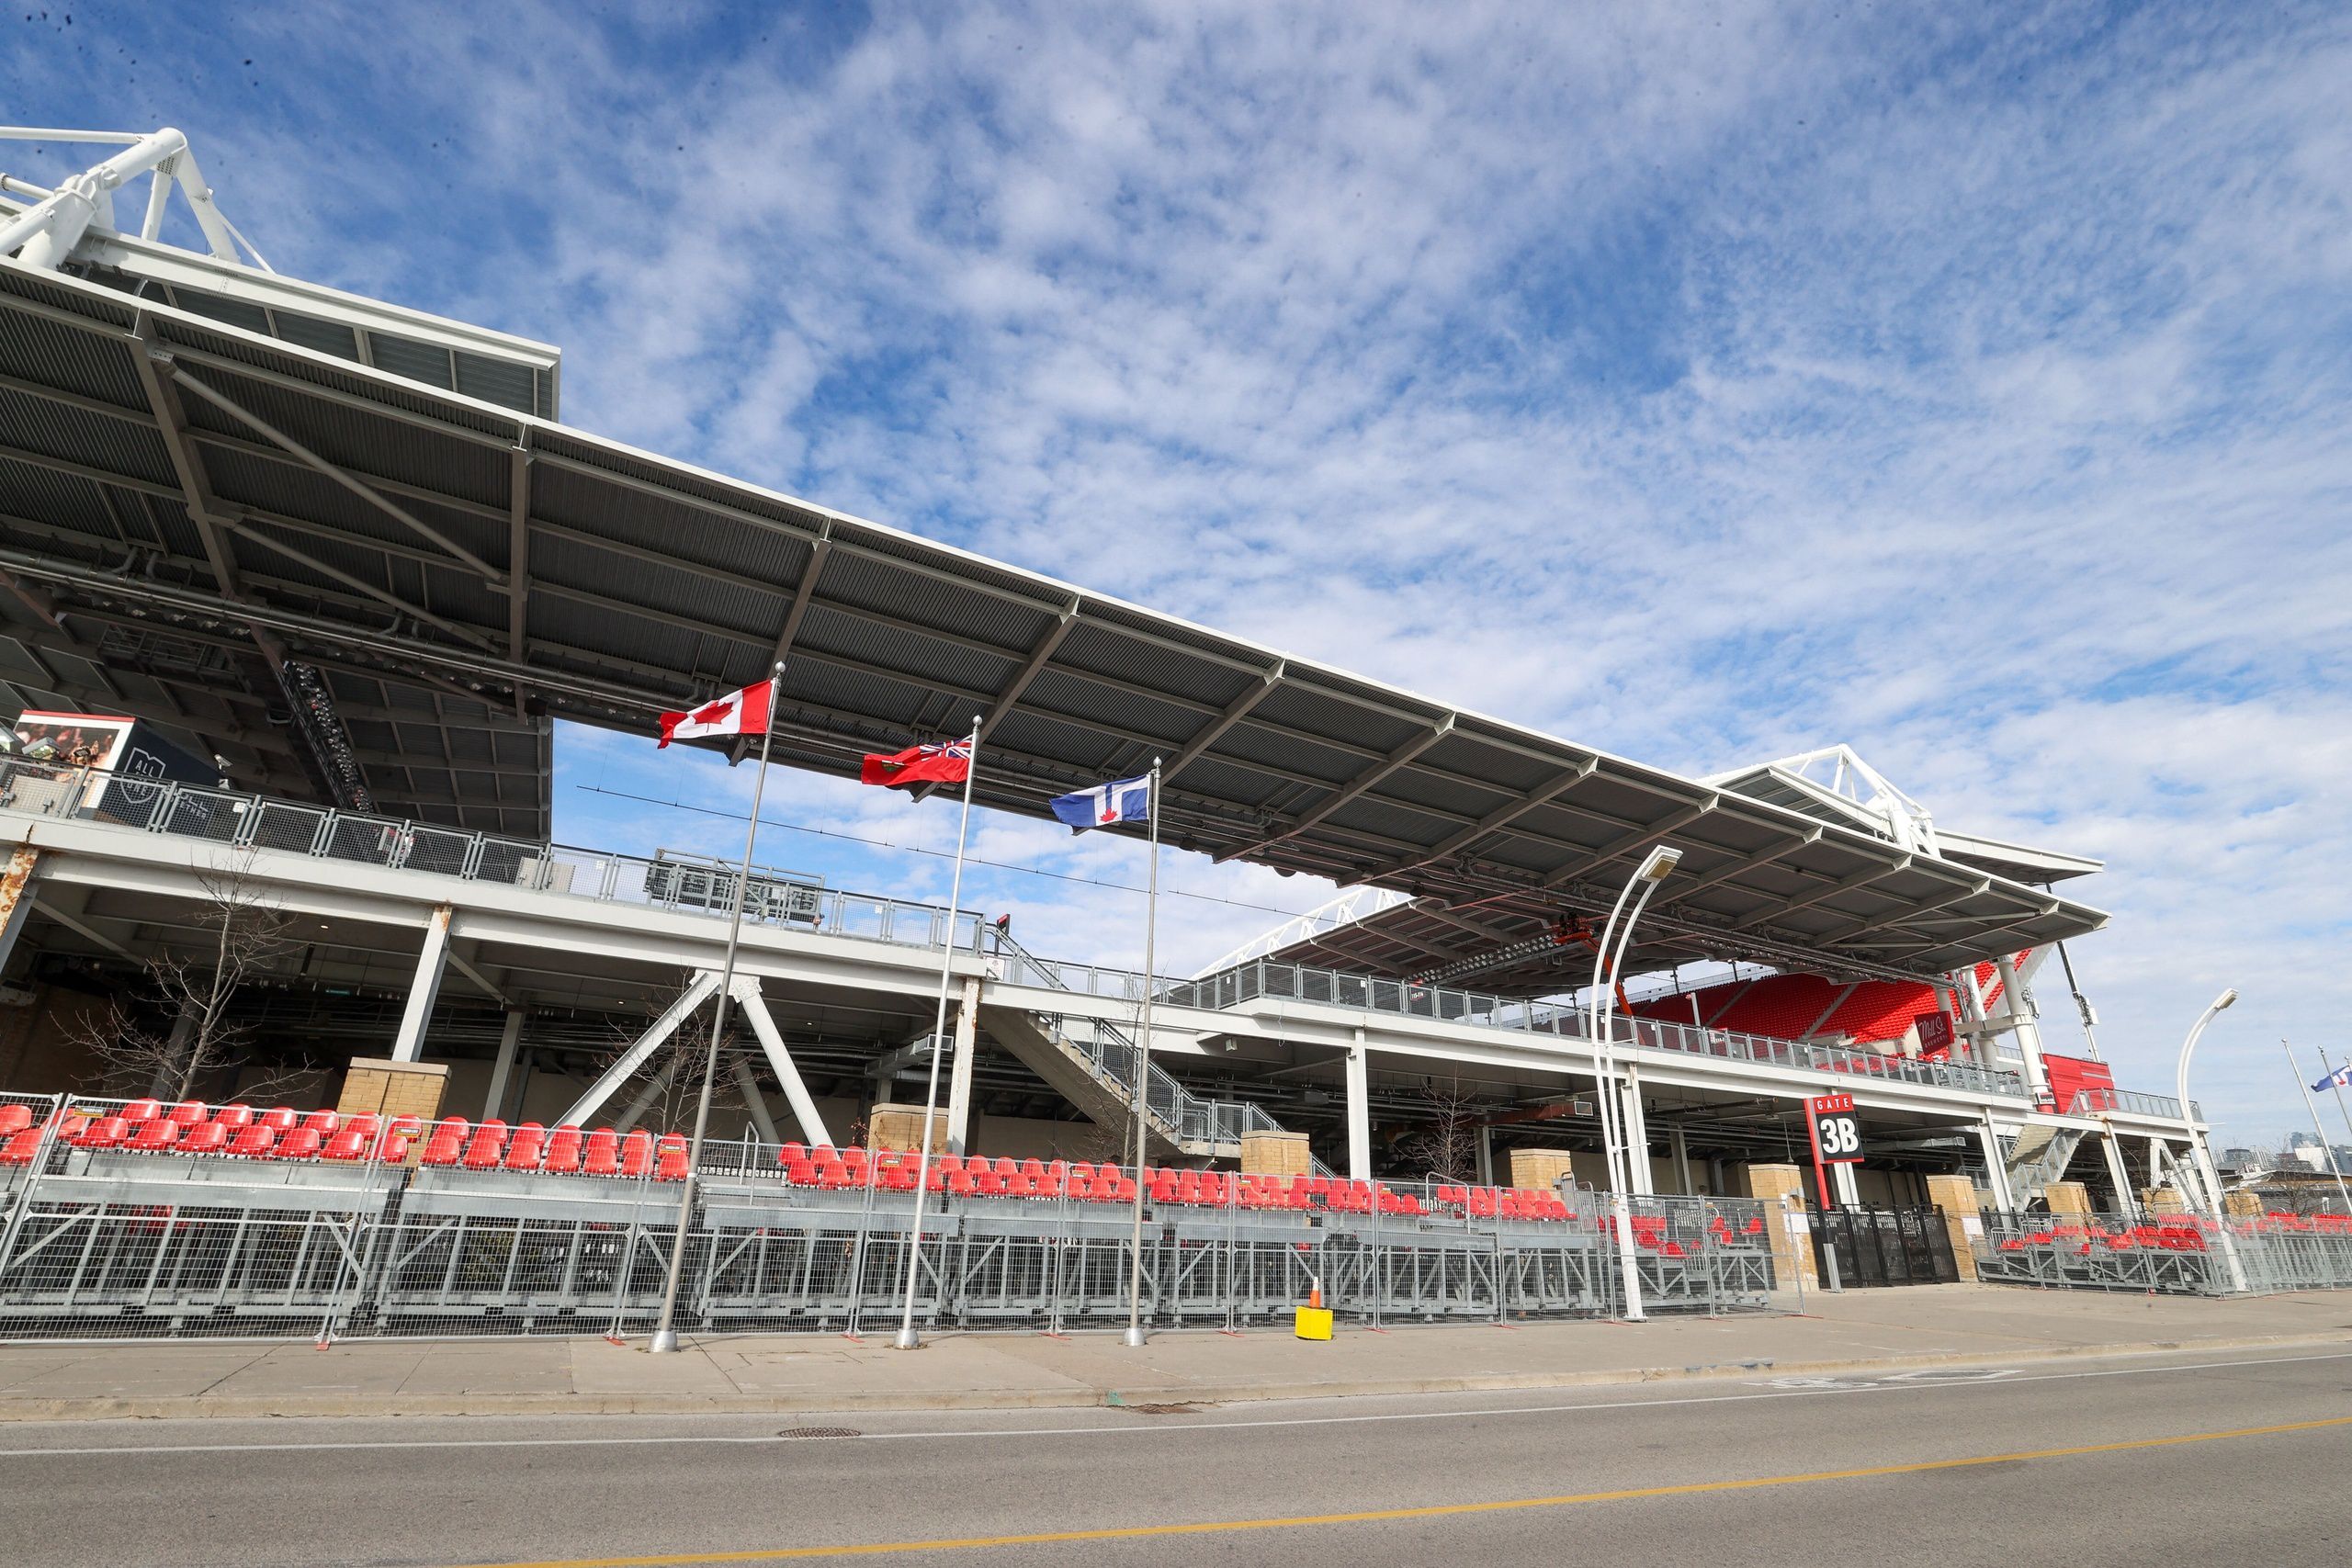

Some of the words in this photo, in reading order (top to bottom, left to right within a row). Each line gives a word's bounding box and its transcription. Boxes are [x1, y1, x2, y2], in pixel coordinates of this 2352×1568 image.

[135, 760, 153, 777] ALL
[1918, 1020, 1936, 1040] Mill
[1817, 1098, 1849, 1110] GATE
[1820, 1118, 1859, 1154] 3B
